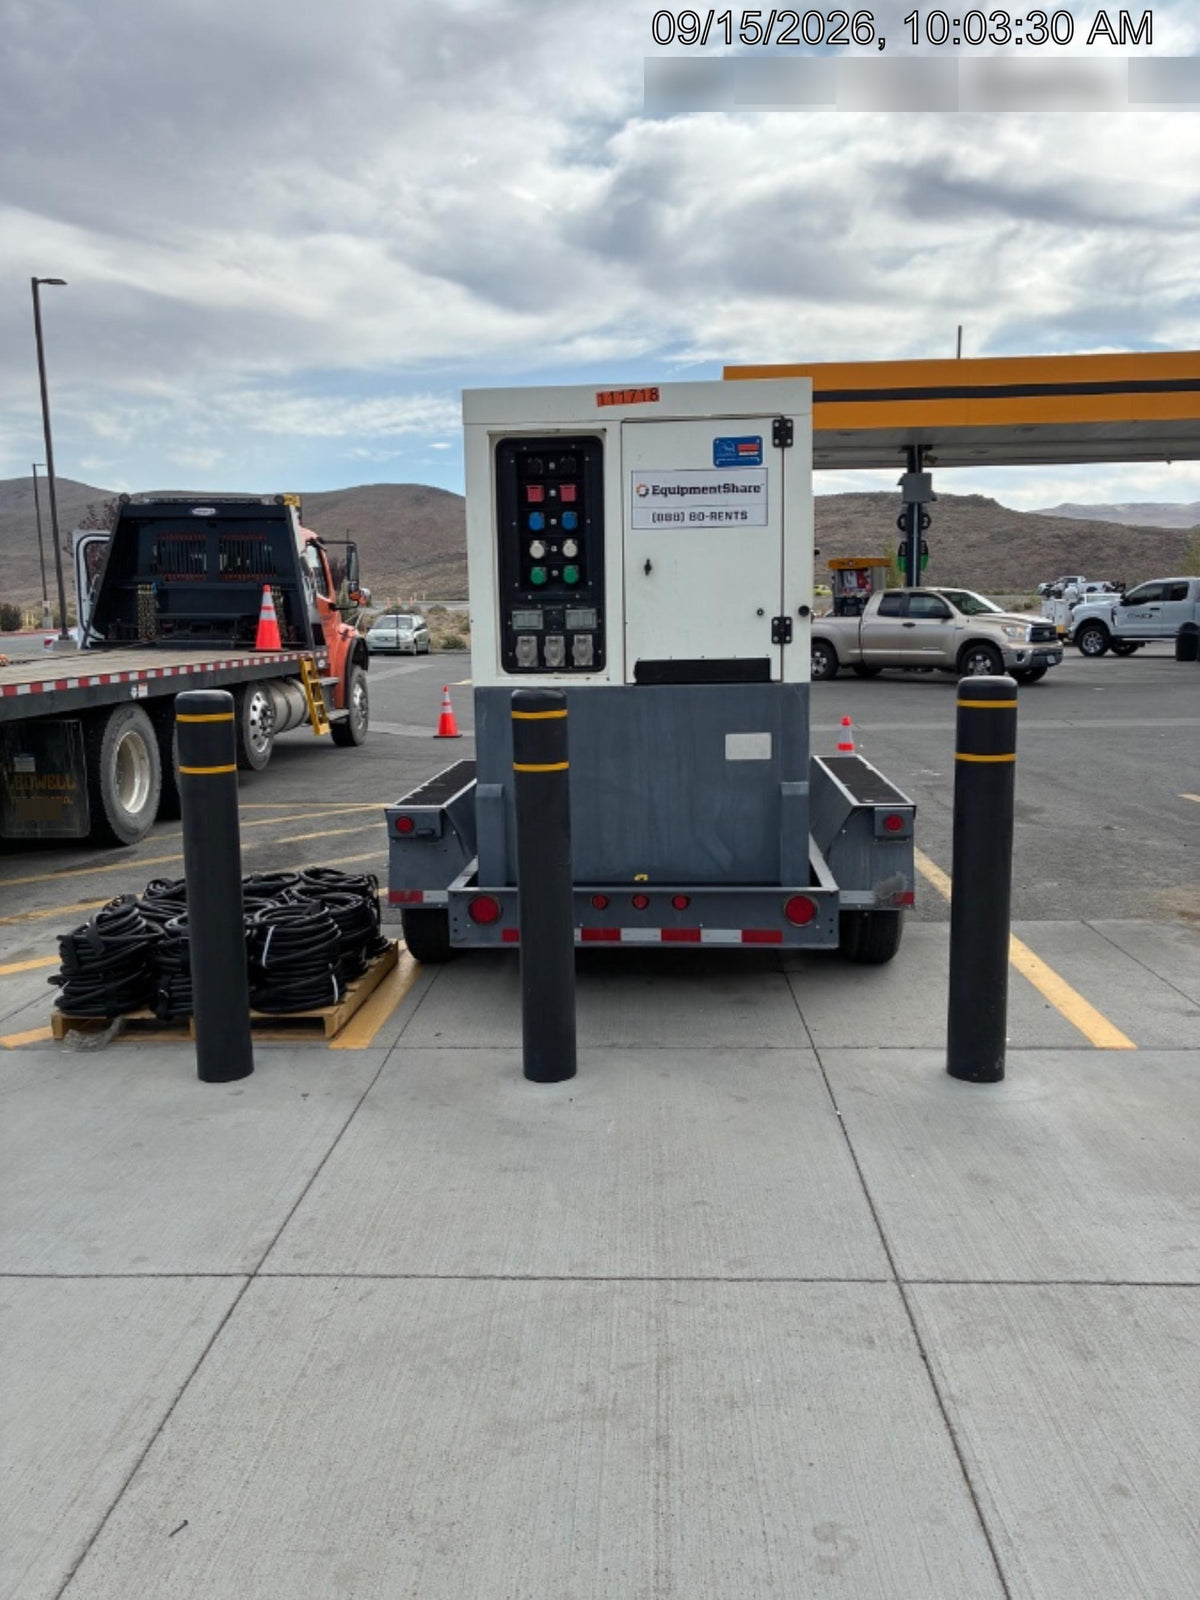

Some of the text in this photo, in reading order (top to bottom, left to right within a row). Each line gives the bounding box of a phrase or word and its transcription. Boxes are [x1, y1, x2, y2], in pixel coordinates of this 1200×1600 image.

[597, 387, 659, 406] 111718
[652, 482, 760, 497] EquipmentShare
[689, 511, 748, 522] 80-RENTS
